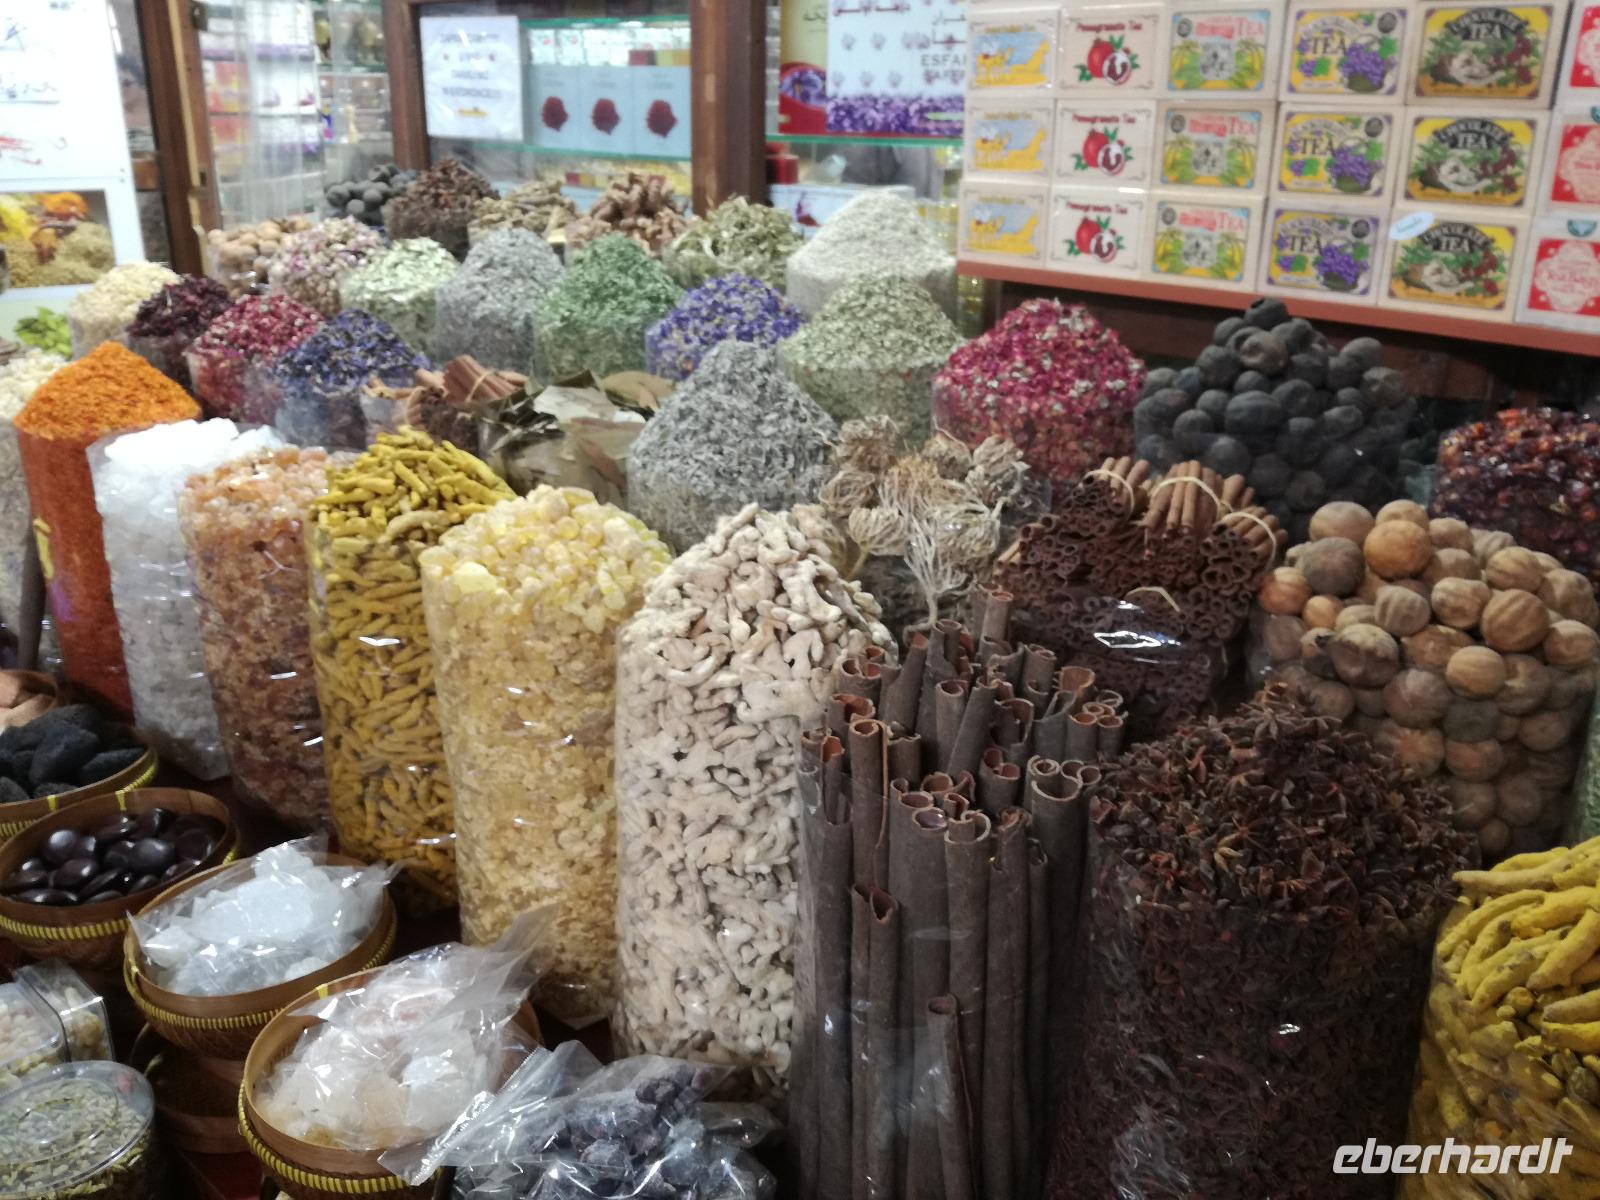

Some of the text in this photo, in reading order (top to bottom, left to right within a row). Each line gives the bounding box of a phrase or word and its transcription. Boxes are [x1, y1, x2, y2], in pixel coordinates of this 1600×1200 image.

[1470, 22, 1503, 40] TEA
[1307, 36, 1347, 55] TEA
[1297, 137, 1337, 157] TEA
[1457, 132, 1489, 150] TEA
[1285, 234, 1323, 256] TEA
[1439, 235, 1471, 253] TEA
